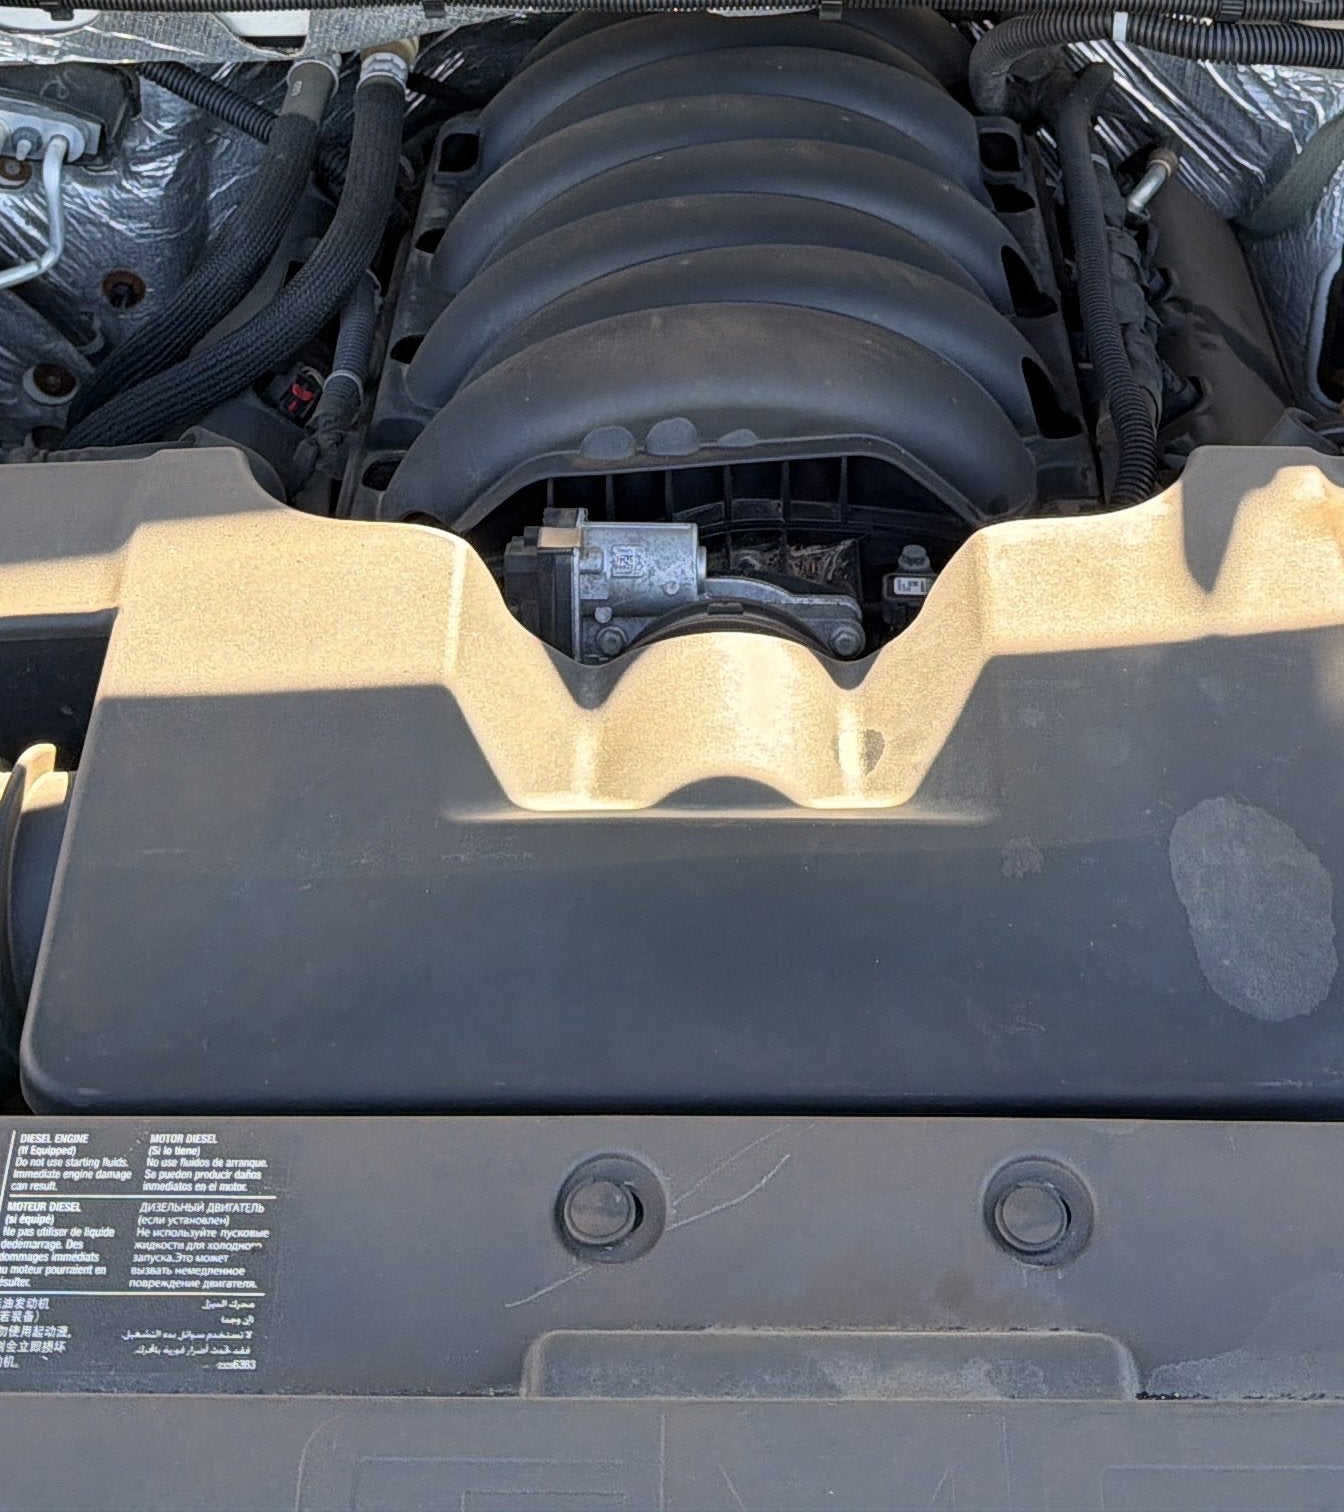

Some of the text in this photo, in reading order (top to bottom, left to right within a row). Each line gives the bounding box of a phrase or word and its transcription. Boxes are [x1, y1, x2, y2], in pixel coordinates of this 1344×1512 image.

[20, 1134, 89, 1144] DIESEL ENGINE
[150, 1134, 218, 1144] MOTOR DIESEL
[30, 1146, 77, 1157] Equipped)
[148, 1146, 201, 1157] (Si lo tiene)
[15, 1157, 129, 1169] Do not use starting fluids.
[146, 1158, 268, 1169] No use fluidos de arranque.
[13, 1169, 132, 1181] Immediate engine damage
[144, 1169, 262, 1180] Se pueden producir daños
[11, 1181, 58, 1191] can result.
[143, 1181, 248, 1191] inmediatos en el motor.
[7, 1201, 82, 1212] MOTEUR DIESEL
[139, 1201, 265, 1214] ДИЗЕЛЬНЫЙ ДВИГАТЕЛЬ
[5, 1214, 18, 1225] (si
[137, 1216, 230, 1226] (если установлен)
[3, 1226, 115, 1239] Ne pas utiliser de liquide
[136, 1228, 270, 1240] Не используйте пусковые
[65, 1239, 84, 1249] Des
[134, 1242, 185, 1251] жидкости
[185, 1242, 205, 1251] для
[195, 1254, 230, 1263] может
[10, 1265, 44, 1275] moteur
[45, 1265, 94, 1276] pourraient
[95, 1266, 107, 1275] en
[130, 1267, 246, 1276] вызвать немедленное
[129, 1279, 258, 1289] повреждение двигателя.
